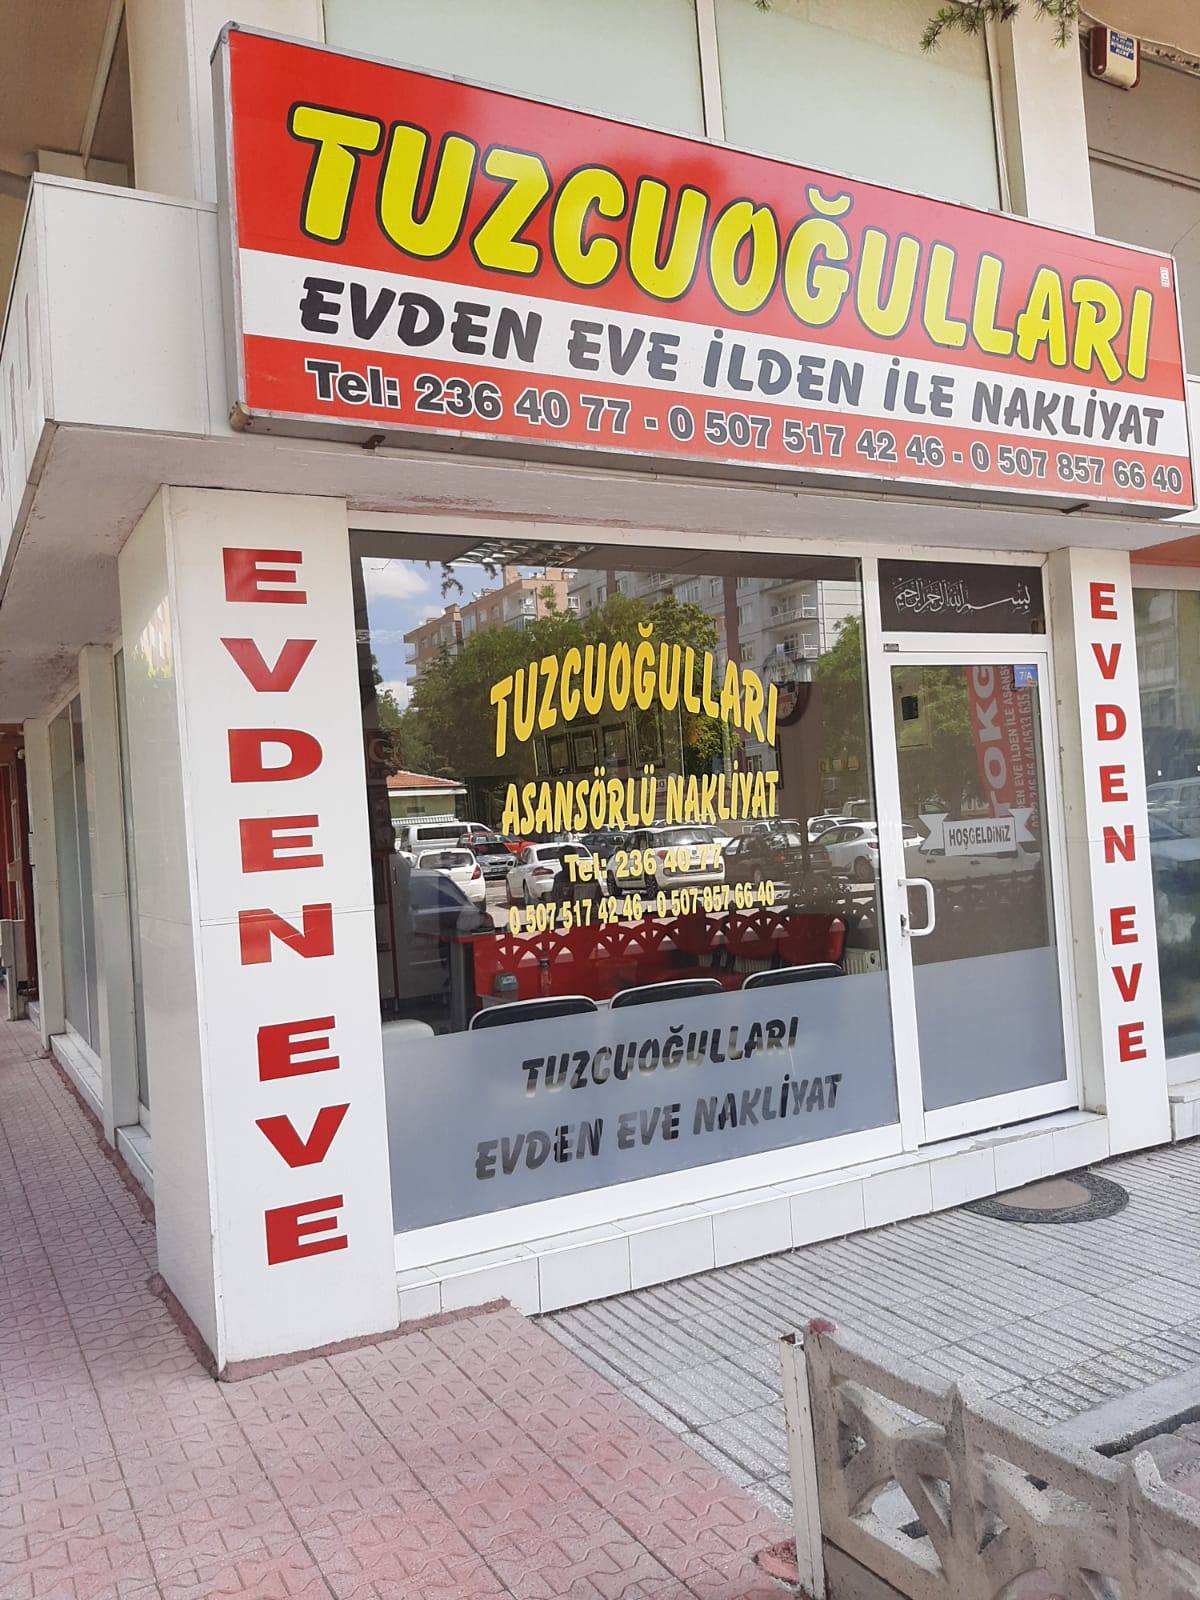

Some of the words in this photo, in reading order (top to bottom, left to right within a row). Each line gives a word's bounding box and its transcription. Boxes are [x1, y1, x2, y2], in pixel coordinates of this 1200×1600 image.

[287, 102, 1154, 384] TUZCUOĞULLARI
[299, 277, 542, 363] EVDEN
[567, 319, 679, 381] EVE
[703, 329, 864, 406] İLDEN
[885, 357, 954, 417] İLE
[971, 381, 1164, 446] NAKLİYAT
[305, 359, 400, 408] Tel:
[414, 374, 502, 420] 236
[514, 387, 570, 429] 40
[579, 394, 632, 435] 77
[668, 406, 694, 443] 0
[704, 411, 771, 449] 507
[783, 421, 845, 457] 517
[856, 430, 898, 463] 42
[906, 435, 945, 466] 46
[971, 442, 991, 473] 0
[997, 446, 1048, 478] 507
[1056, 455, 1104, 484] 857
[1112, 462, 1145, 488] 66
[1152, 466, 1184, 494] 40
[220, 547, 334, 966] EVDEN
[490, 622, 778, 758] TUZCUOĞULLARI
[1089, 582, 1136, 864] EVDEN
[502, 764, 655, 837] ASANSÖRLÜ
[666, 759, 779, 826] NAKLİYAT
[564, 853, 608, 882] Tel:
[615, 849, 657, 878] 236
[664, 846, 690, 873] 40
[699, 844, 722, 869] 77
[509, 906, 520, 935] 0
[526, 902, 556, 934] 507
[562, 900, 592, 929] 517
[598, 896, 619, 924] 42
[622, 893, 643, 921] 46
[656, 891, 667, 918] 0
[671, 888, 698, 916] 507
[703, 885, 730, 913] 857
[735, 882, 753, 909] 66
[758, 879, 775, 906] 40
[1110, 905, 1147, 1063] EVE
[522, 1016, 799, 1098] TUZCUOĞULLARI
[255, 1015, 351, 1266] EVE
[475, 1118, 604, 1180] EVDEN
[617, 1103, 681, 1151] EVE
[693, 1073, 842, 1135] NAKLİYAT
